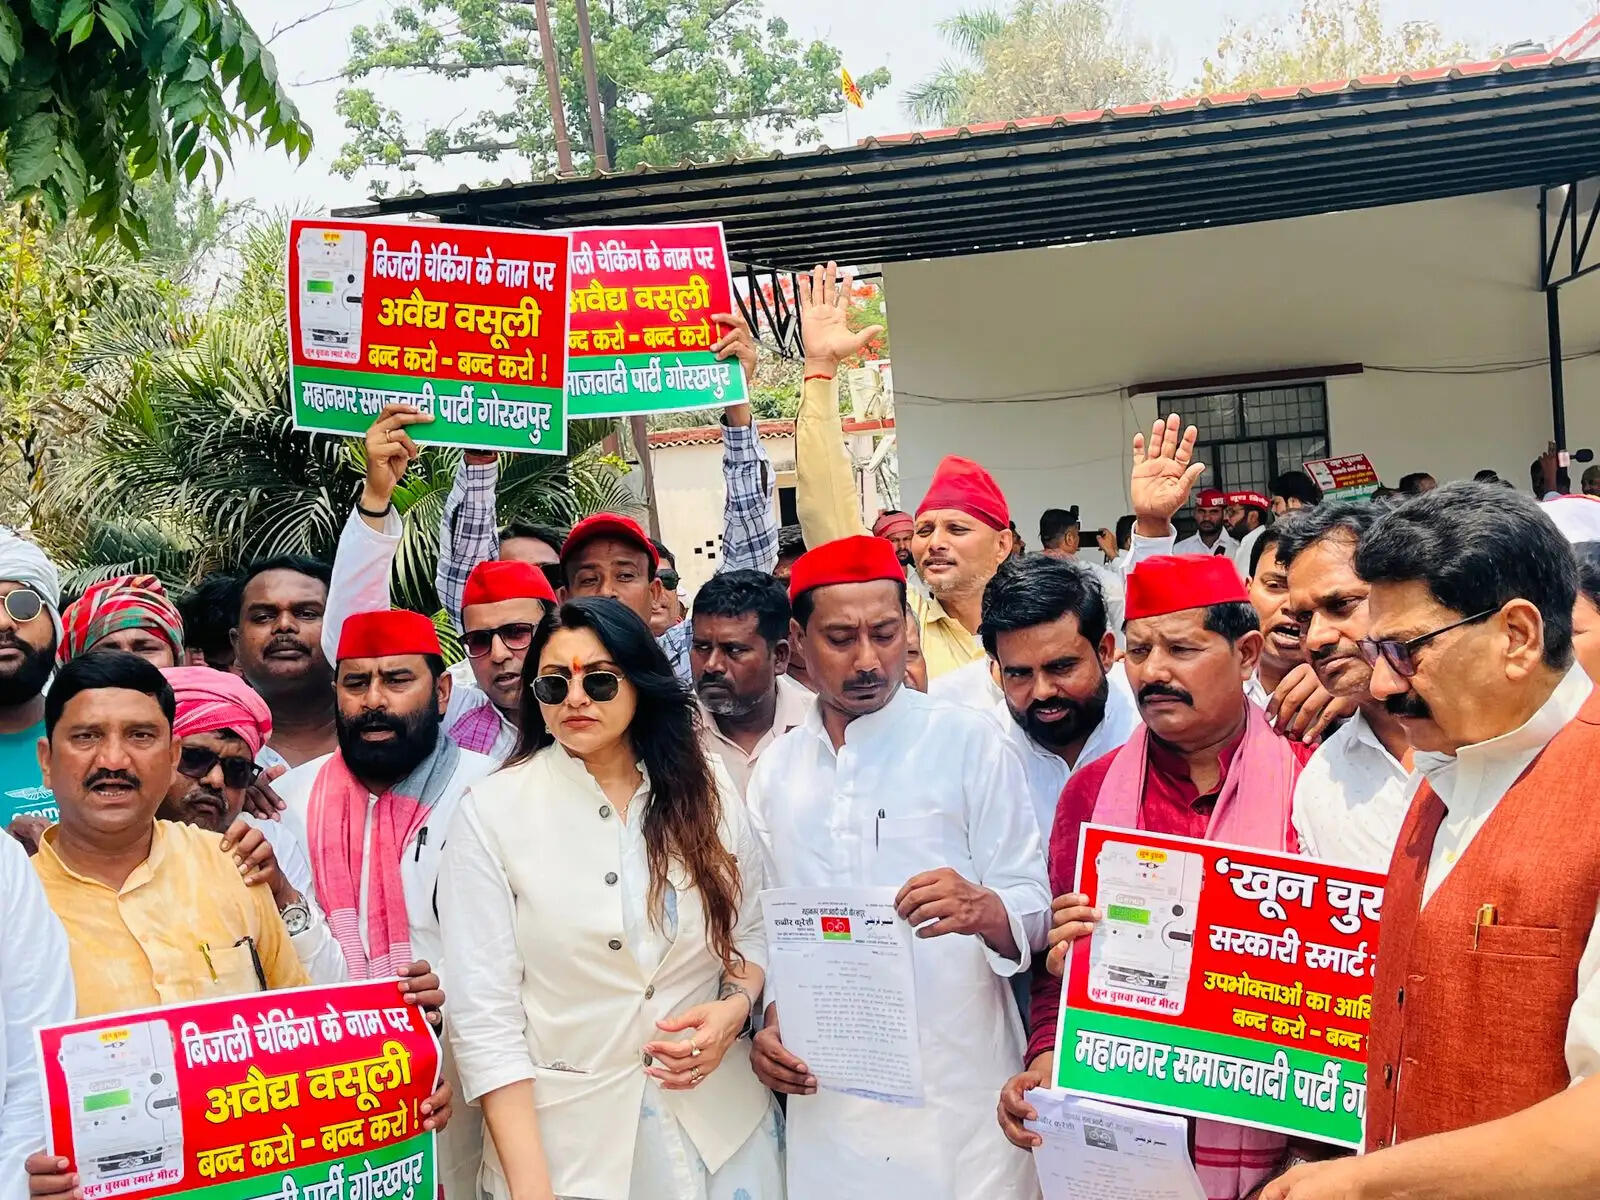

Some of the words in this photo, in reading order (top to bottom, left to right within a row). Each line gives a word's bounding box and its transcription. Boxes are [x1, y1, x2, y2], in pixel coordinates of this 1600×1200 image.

[373, 238, 421, 282] बिजली
[424, 240, 473, 284] चेकिंग
[475, 246, 493, 285] के
[496, 259, 530, 289] नाम
[533, 260, 556, 291] पर
[596, 239, 642, 273] चेकिंग
[643, 240, 660, 271] के
[662, 247, 693, 271] नाम
[694, 247, 716, 270] पर
[377, 287, 449, 330] अवैद्य
[454, 295, 542, 349] वसूली
[633, 274, 711, 323] वसूली
[592, 321, 625, 350] करो
[643, 327, 676, 349] बन्द
[678, 318, 711, 347] करो
[368, 344, 401, 370] बन्द
[403, 340, 437, 373] करो
[457, 351, 494, 378] बन्द
[498, 348, 534, 381] करो
[568, 358, 629, 397] माजवादी
[630, 357, 662, 393] पार्टी
[664, 358, 732, 400] गोरखपुर
[301, 381, 358, 413] महानगर
[439, 384, 475, 425] पार्टी
[477, 389, 552, 445] गोरखपुर
[1208, 924, 1301, 964] सरकारी
[1305, 942, 1368, 978] स्मार्ट
[1203, 970, 1302, 1007] उपभोक्ताओं
[1306, 992, 1333, 1013] का
[181, 1013, 254, 1069] बिजली
[257, 1007, 319, 1055] चेकिंग
[321, 1003, 343, 1042] के
[345, 1007, 383, 1041] नाम
[383, 1004, 414, 1033] पर
[1232, 1007, 1267, 1032] बन्द
[1271, 1015, 1306, 1040] करो
[1325, 1026, 1363, 1052] बन्द
[204, 1066, 299, 1124] अवैद्य
[306, 1040, 413, 1111] वसूली
[1074, 1029, 1172, 1080] महानगर
[1172, 1050, 1290, 1101] समाजवादी
[1293, 1061, 1341, 1112] पार्टी
[196, 1147, 245, 1179] बन्द
[248, 1123, 297, 1166] करो
[320, 1118, 364, 1154] बन्द
[368, 1099, 409, 1144] करो
[348, 1152, 424, 1200] गोरखपुर
